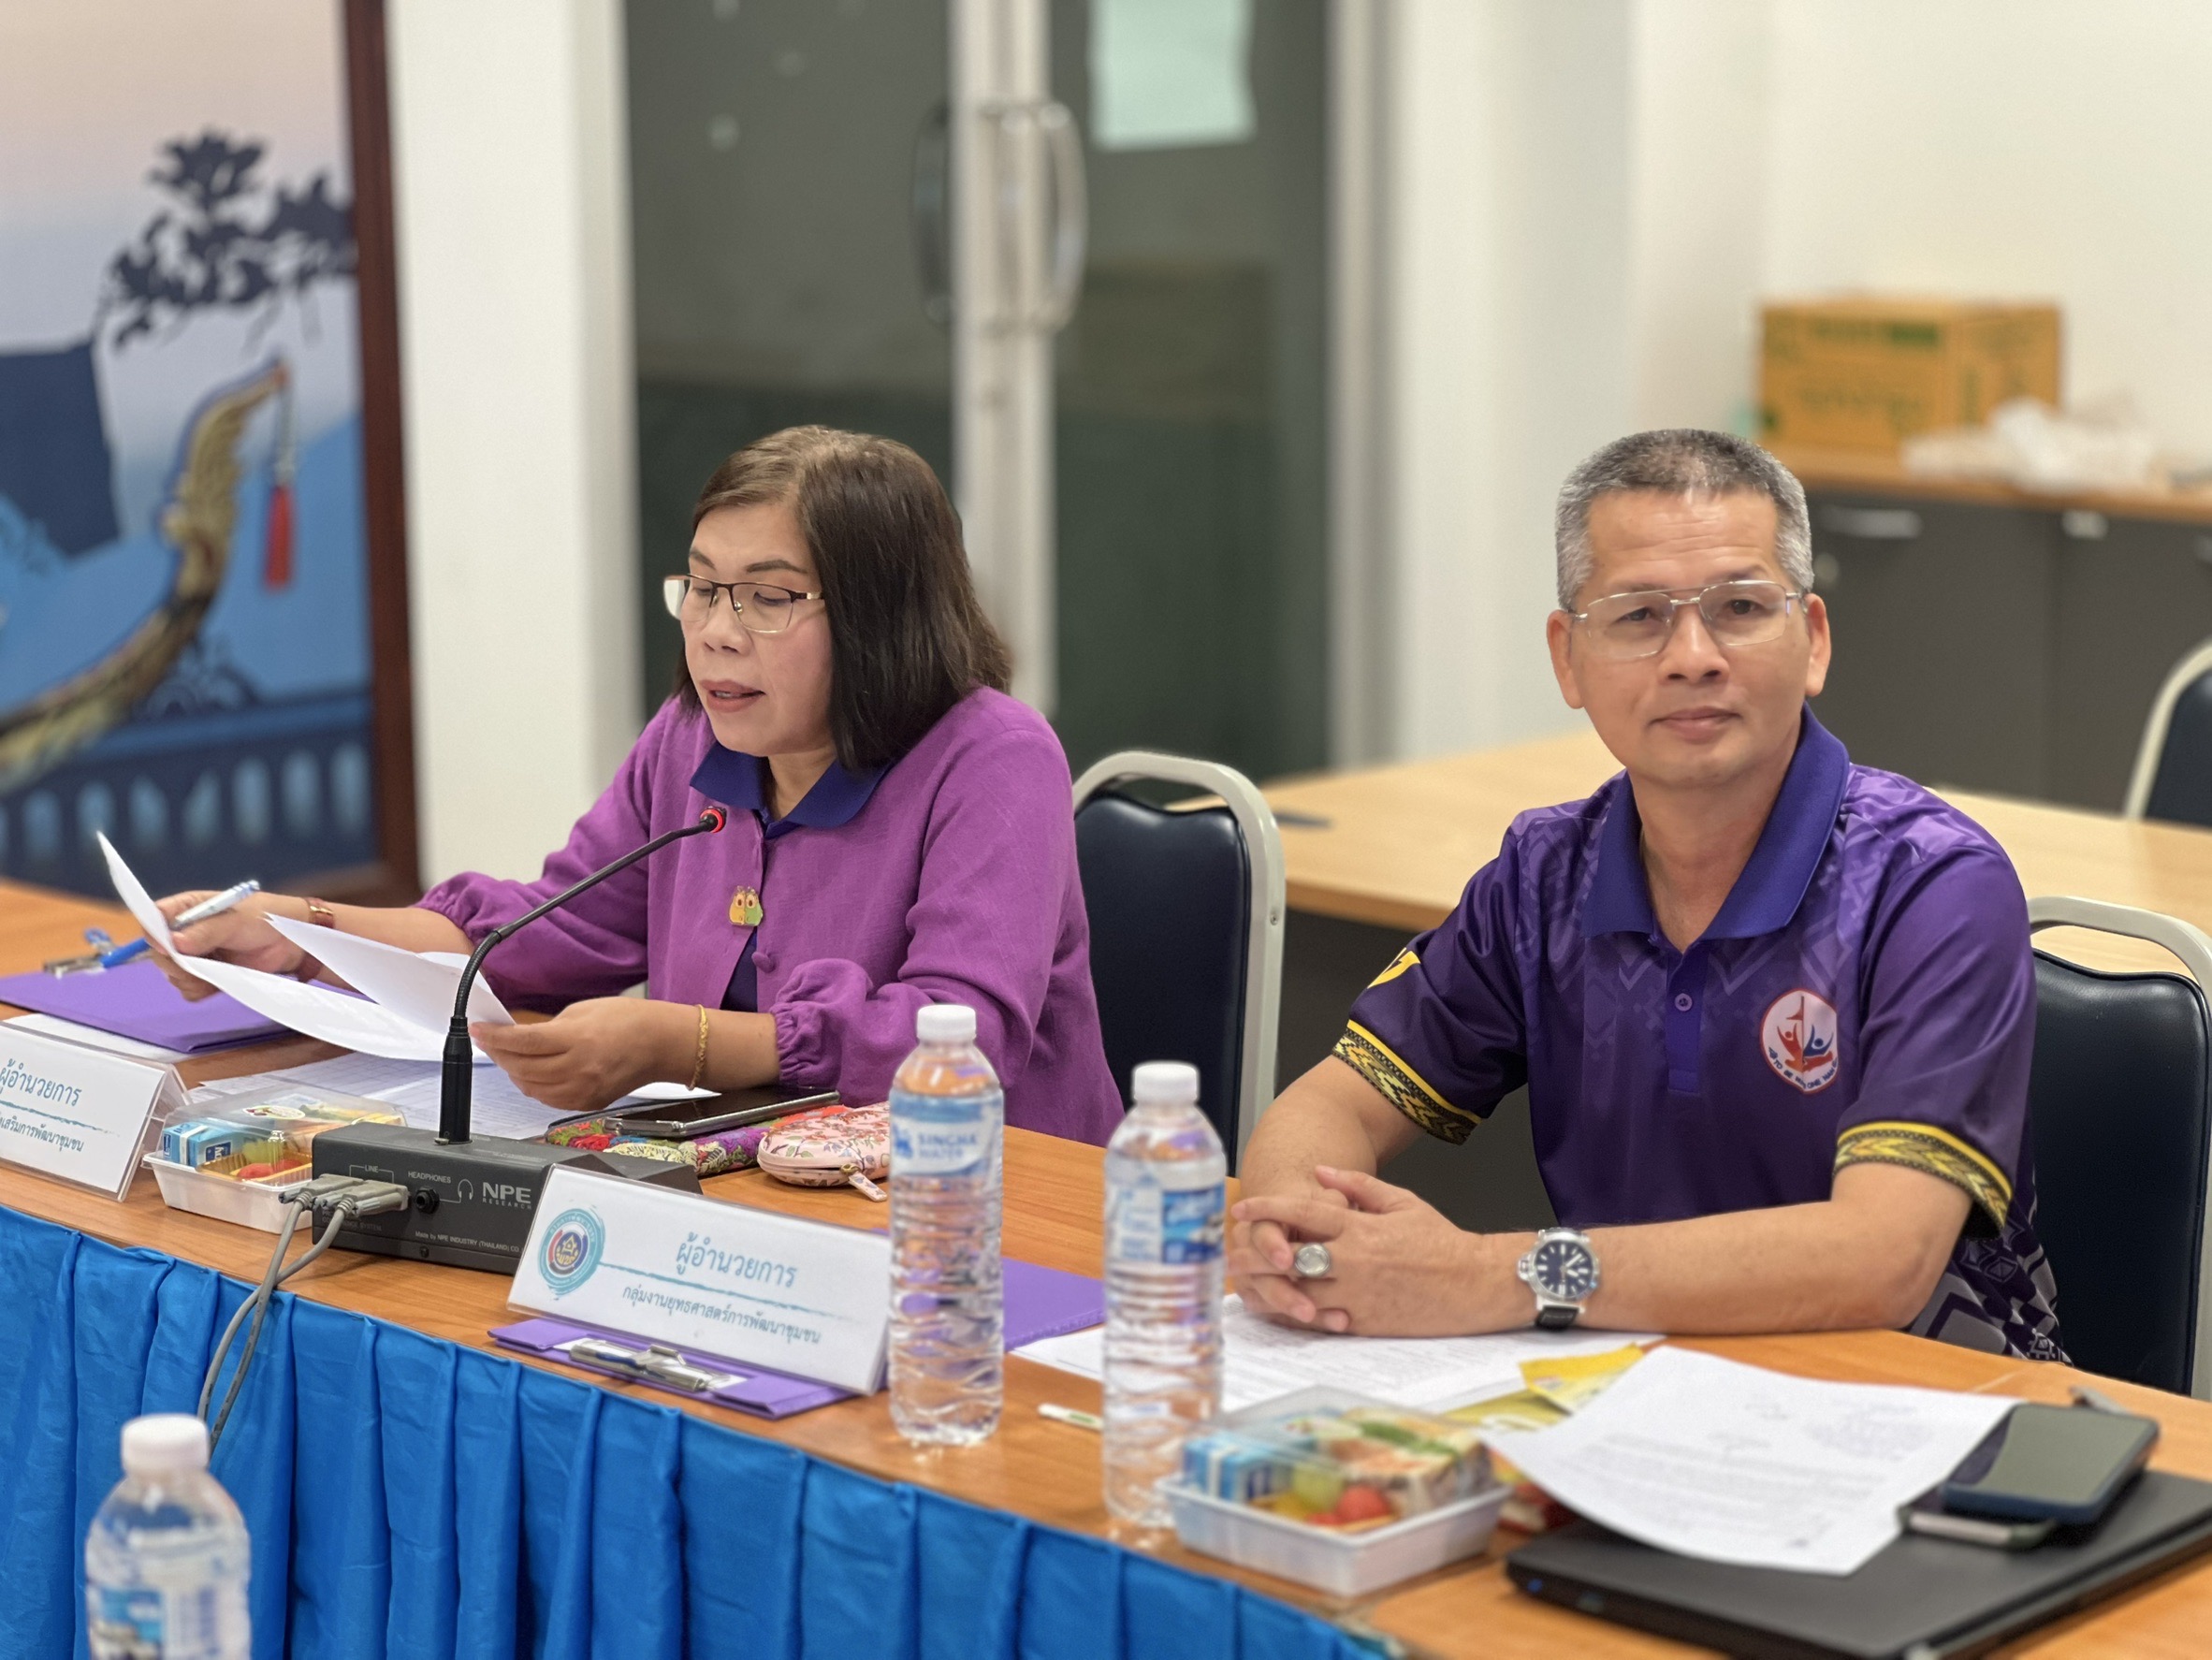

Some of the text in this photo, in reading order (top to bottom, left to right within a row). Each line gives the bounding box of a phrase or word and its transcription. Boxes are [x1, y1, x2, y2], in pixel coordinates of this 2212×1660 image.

[0, 1058, 82, 1106] ผู้อำนวยการ
[364, 1164, 379, 1173] LINE
[407, 1171, 451, 1184] HEADPHONES
[482, 1181, 531, 1204] NPE
[482, 1198, 531, 1210] RESEARCH
[415, 1230, 429, 1239] Made
[449, 1236, 478, 1246] INDUSTRY
[675, 1231, 798, 1289] ผู้อำนวยการ
